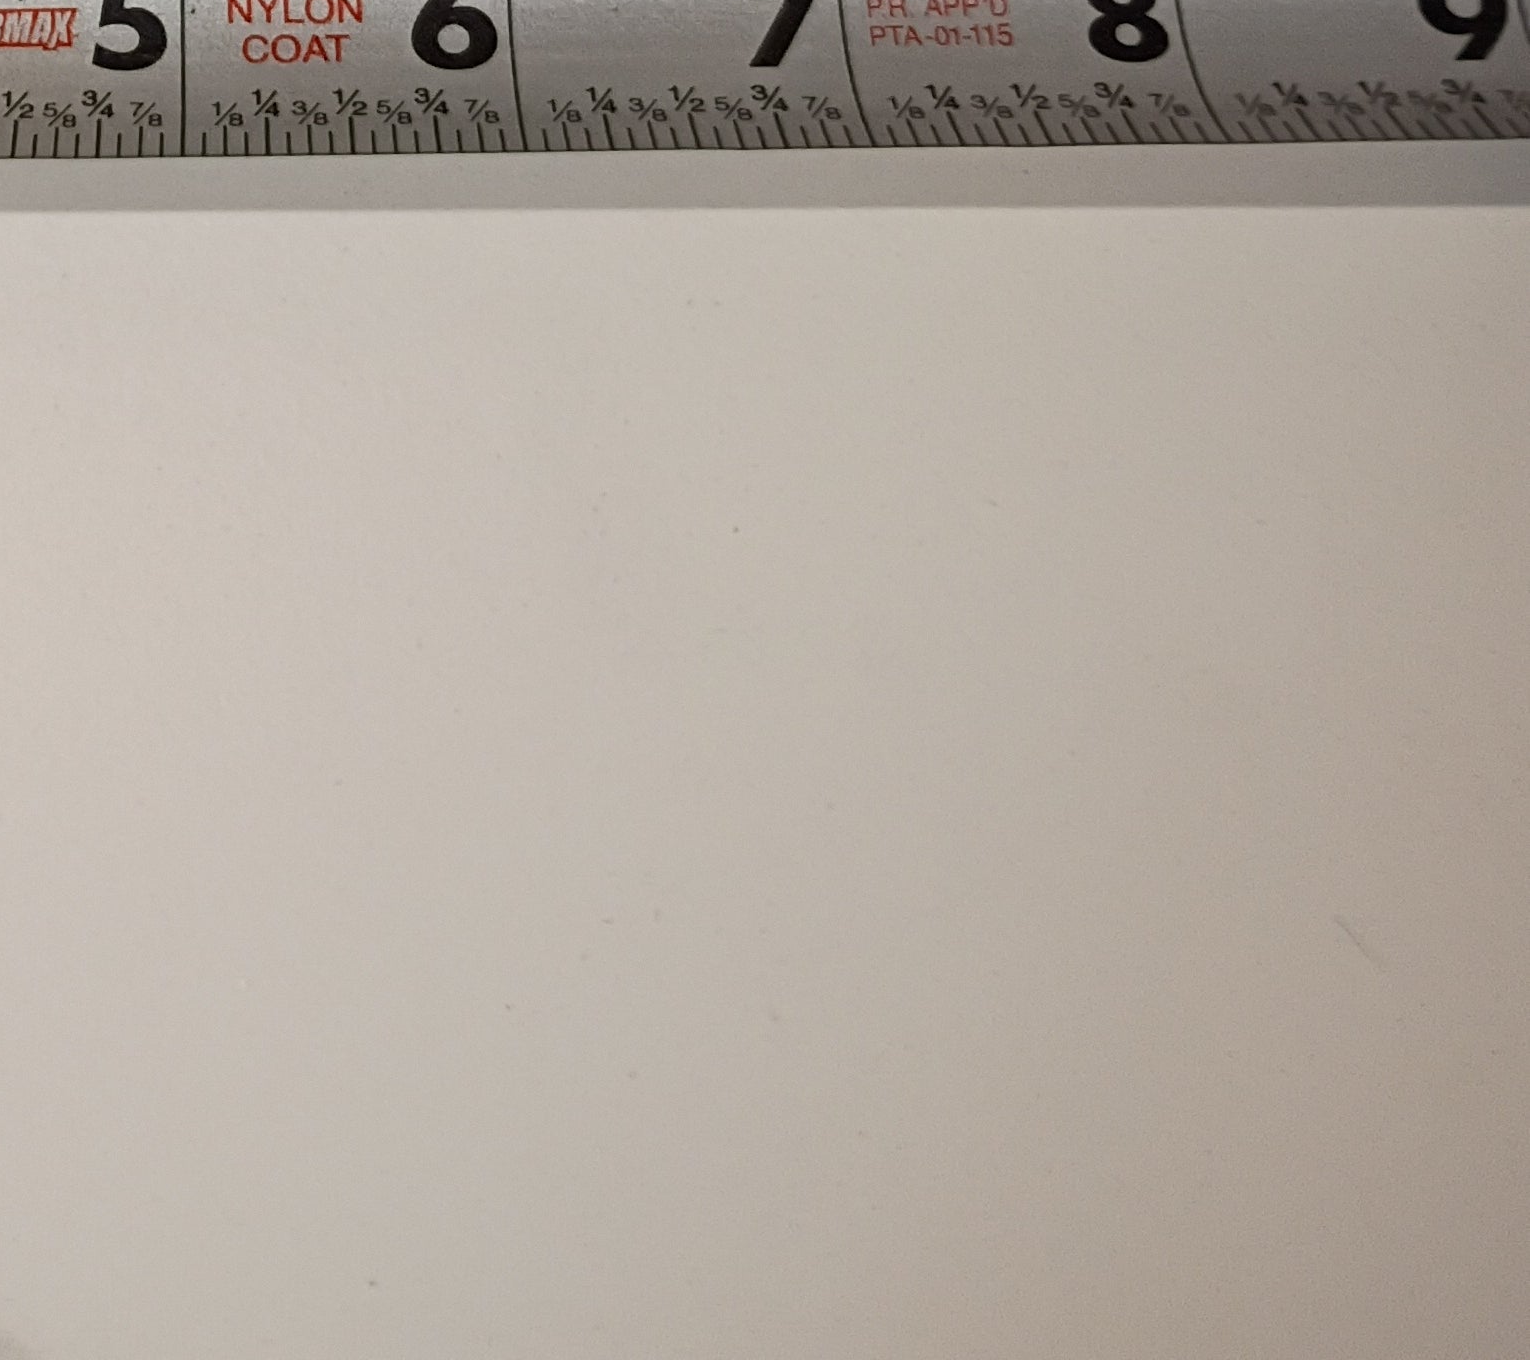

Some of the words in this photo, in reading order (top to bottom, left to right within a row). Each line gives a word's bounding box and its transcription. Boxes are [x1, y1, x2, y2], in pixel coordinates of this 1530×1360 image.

[242, 34, 350, 64] COAT
[869, 22, 1015, 48] PTA-01-115
[2, 90, 34, 119] 1/2
[43, 102, 77, 128] 5/8
[82, 89, 115, 118] 3/4
[130, 101, 163, 127] 7/8
[212, 101, 244, 127] 1/8
[252, 88, 280, 117] 1/4
[292, 100, 329, 125] 3/8
[333, 88, 368, 116] 1/2
[376, 100, 413, 125] 5/8
[414, 87, 450, 115] 3/4
[464, 99, 500, 123] 7/8
[547, 98, 582, 122] 1/8
[586, 86, 617, 113] 1/4
[628, 97, 668, 121] 3/8
[668, 85, 706, 113] 1/2
[714, 96, 753, 120] 5/8
[750, 84, 789, 111] 3/4
[801, 95, 842, 120] 7/8
[890, 94, 926, 120] 1/8
[924, 83, 960, 110] 1/4
[970, 94, 1014, 119] 3/8
[1009, 83, 1053, 110] 1/2
[1057, 93, 1102, 118] 5/8
[1093, 81, 1134, 108] 3/4
[1147, 91, 1191, 117] 7/8
